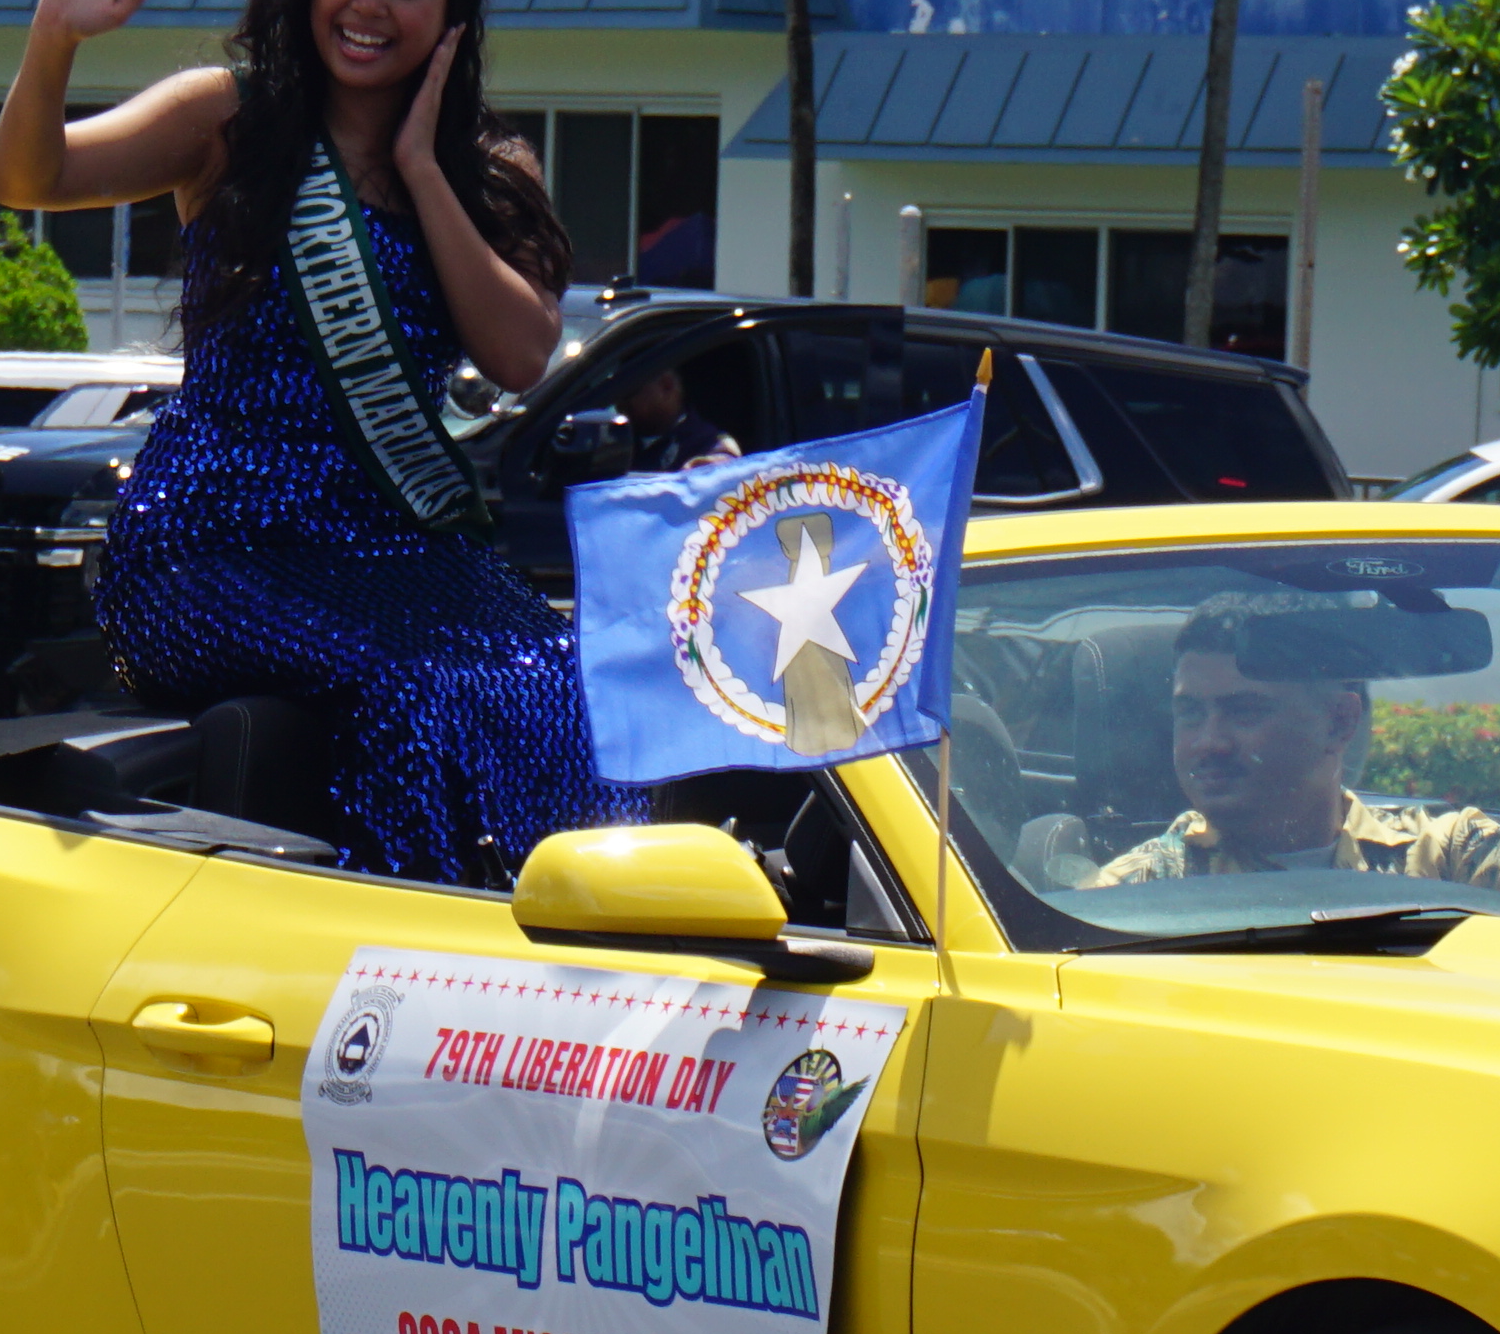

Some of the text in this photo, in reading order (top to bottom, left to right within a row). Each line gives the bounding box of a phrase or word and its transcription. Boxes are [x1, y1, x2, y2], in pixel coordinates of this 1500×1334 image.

[287, 171, 475, 522] NORTHERN MARIANAS
[1346, 558, 1408, 576] Ford
[424, 1028, 504, 1088] 79TH
[507, 1036, 661, 1109] LIBERATION
[665, 1056, 736, 1115] DAY
[332, 1147, 820, 1322] Heavenly Pangelinan
